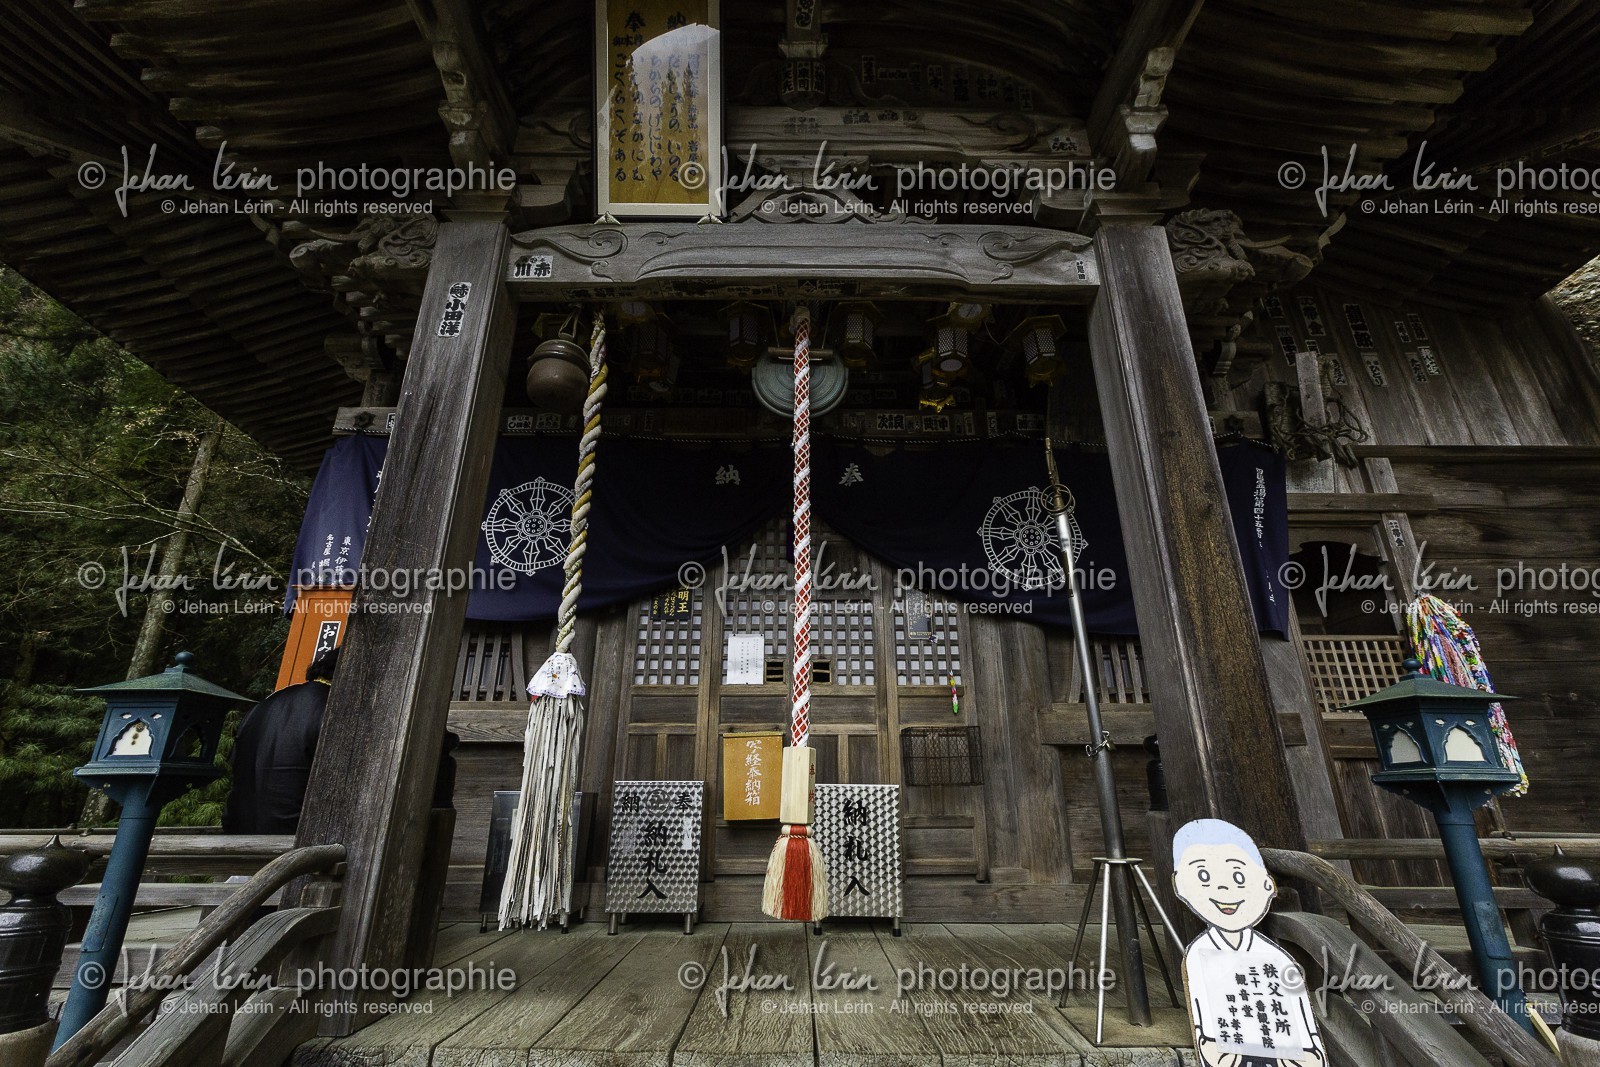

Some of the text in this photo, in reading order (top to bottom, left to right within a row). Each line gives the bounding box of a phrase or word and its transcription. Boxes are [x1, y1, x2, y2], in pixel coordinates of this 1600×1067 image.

[714, 463, 864, 487] 奉 納
[621, 792, 692, 813] 奉 納
[637, 821, 668, 899] 納札入
[842, 799, 870, 896] 納札入
[1235, 972, 1254, 1018] 観音堂
[1262, 963, 1291, 1036] 秩父札所
[1217, 1017, 1231, 1042] 弘子
